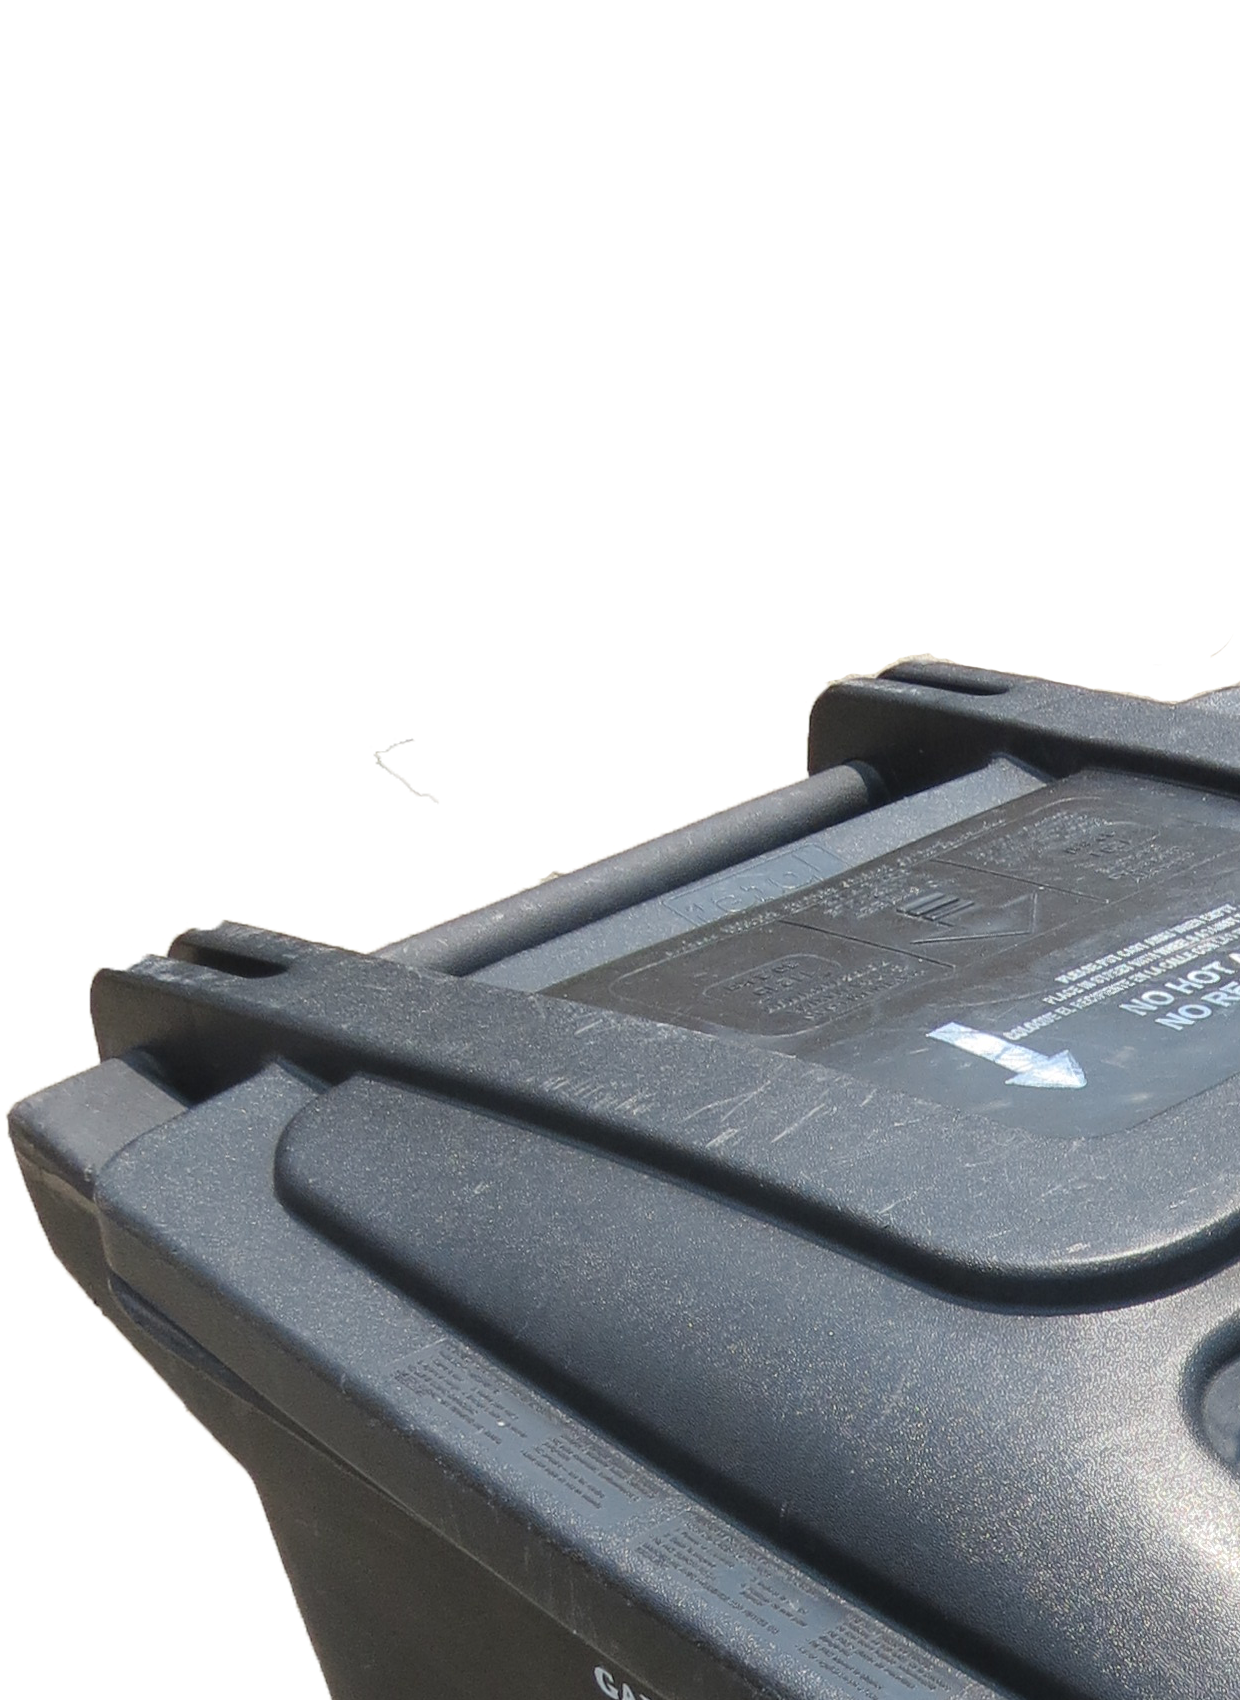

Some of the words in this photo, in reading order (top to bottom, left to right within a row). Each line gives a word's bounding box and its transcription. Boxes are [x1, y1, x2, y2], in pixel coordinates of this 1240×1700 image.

[1119, 988, 1174, 1018] NO
[1164, 961, 1237, 996] HOT
[1155, 999, 1213, 1032] NO
